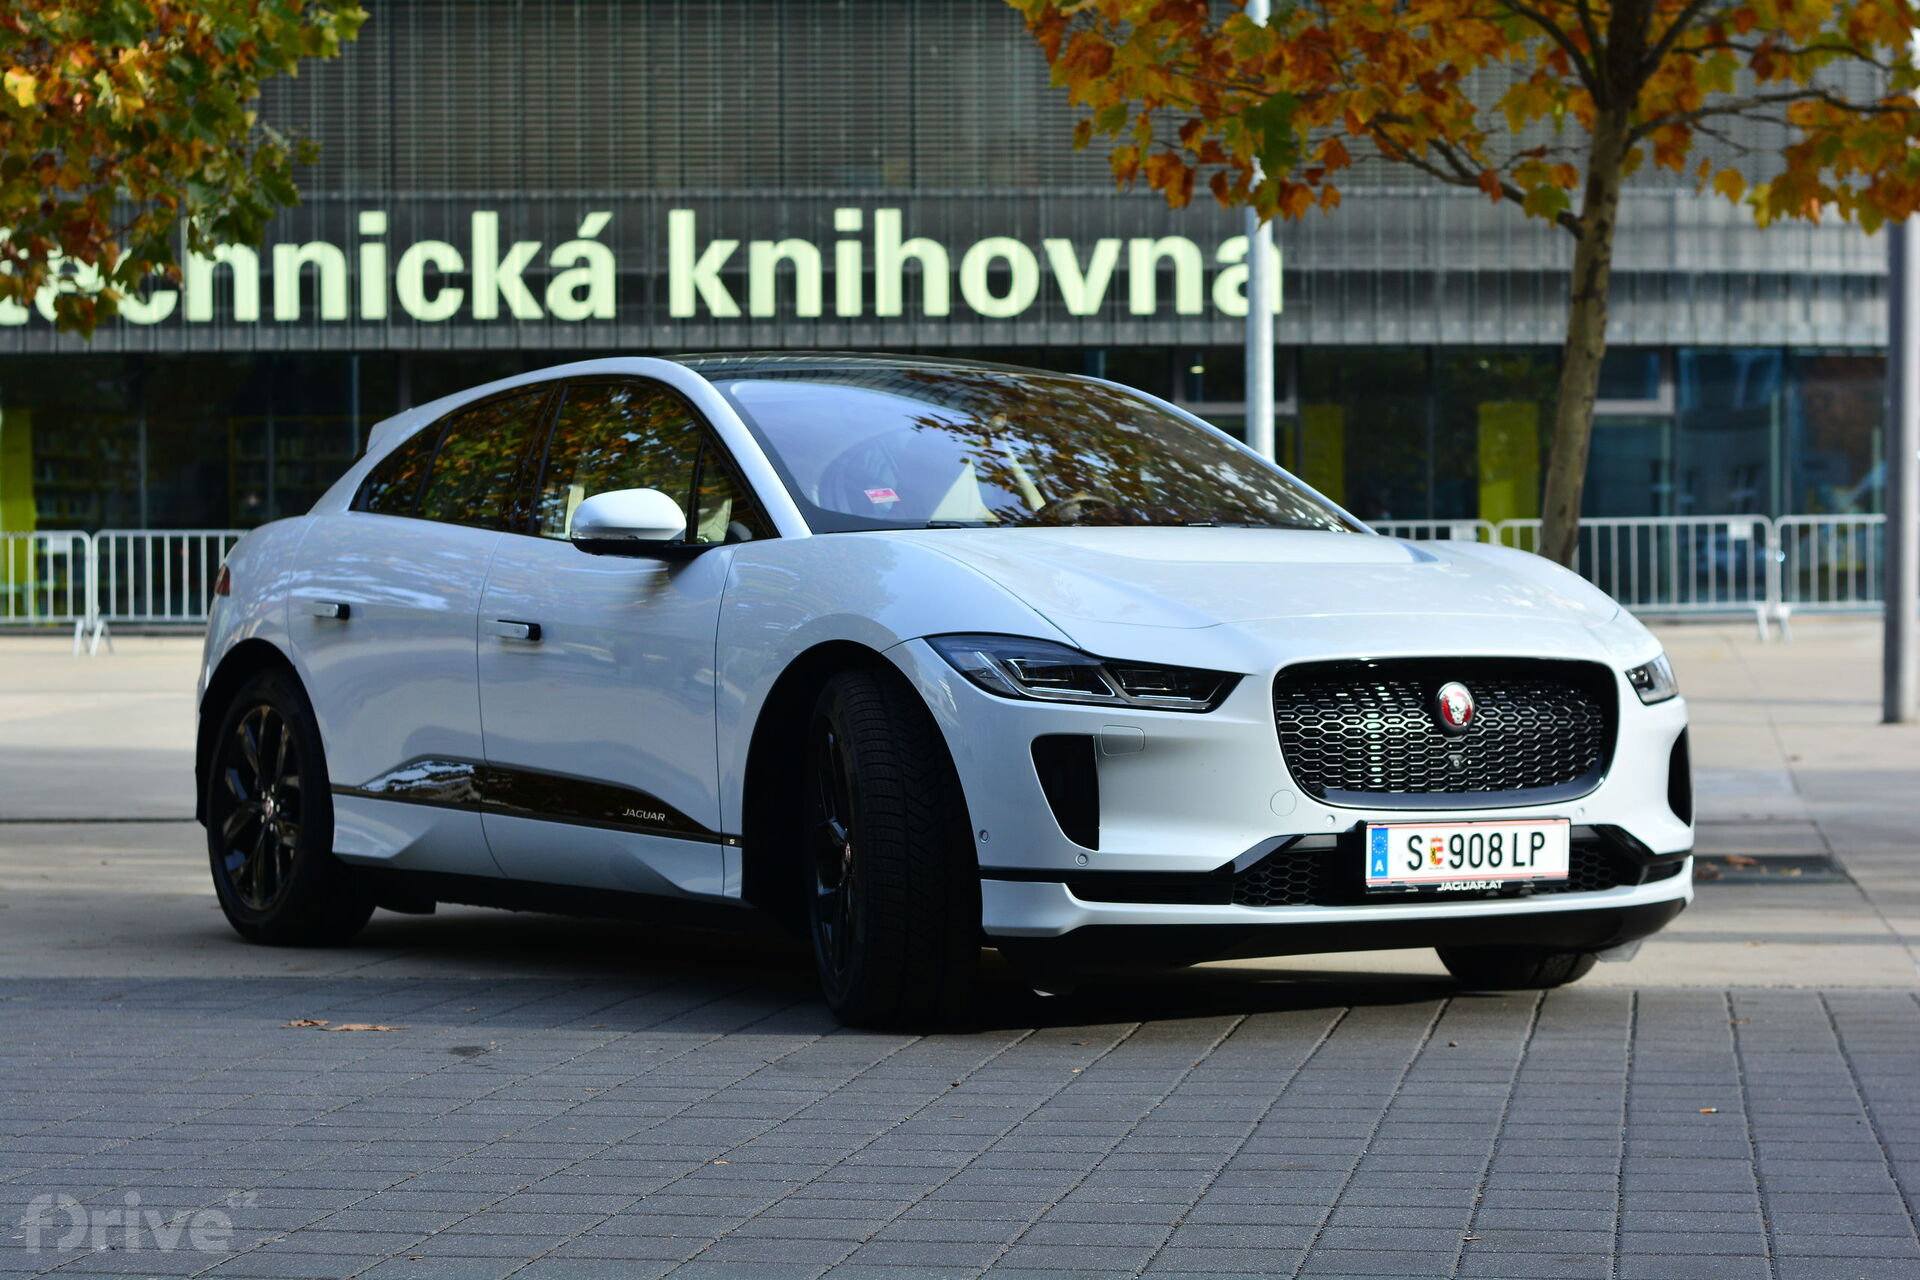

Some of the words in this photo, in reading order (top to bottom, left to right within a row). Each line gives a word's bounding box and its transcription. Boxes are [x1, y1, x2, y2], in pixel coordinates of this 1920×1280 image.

[668, 208, 1283, 318] knihovna
[622, 808, 666, 821] JAGUAR
[1407, 834, 1423, 871] S
[1449, 832, 1503, 869] 908
[1512, 831, 1545, 868] LP
[1375, 860, 1385, 872] A
[1436, 880, 1505, 892] JAGUAR.AT
